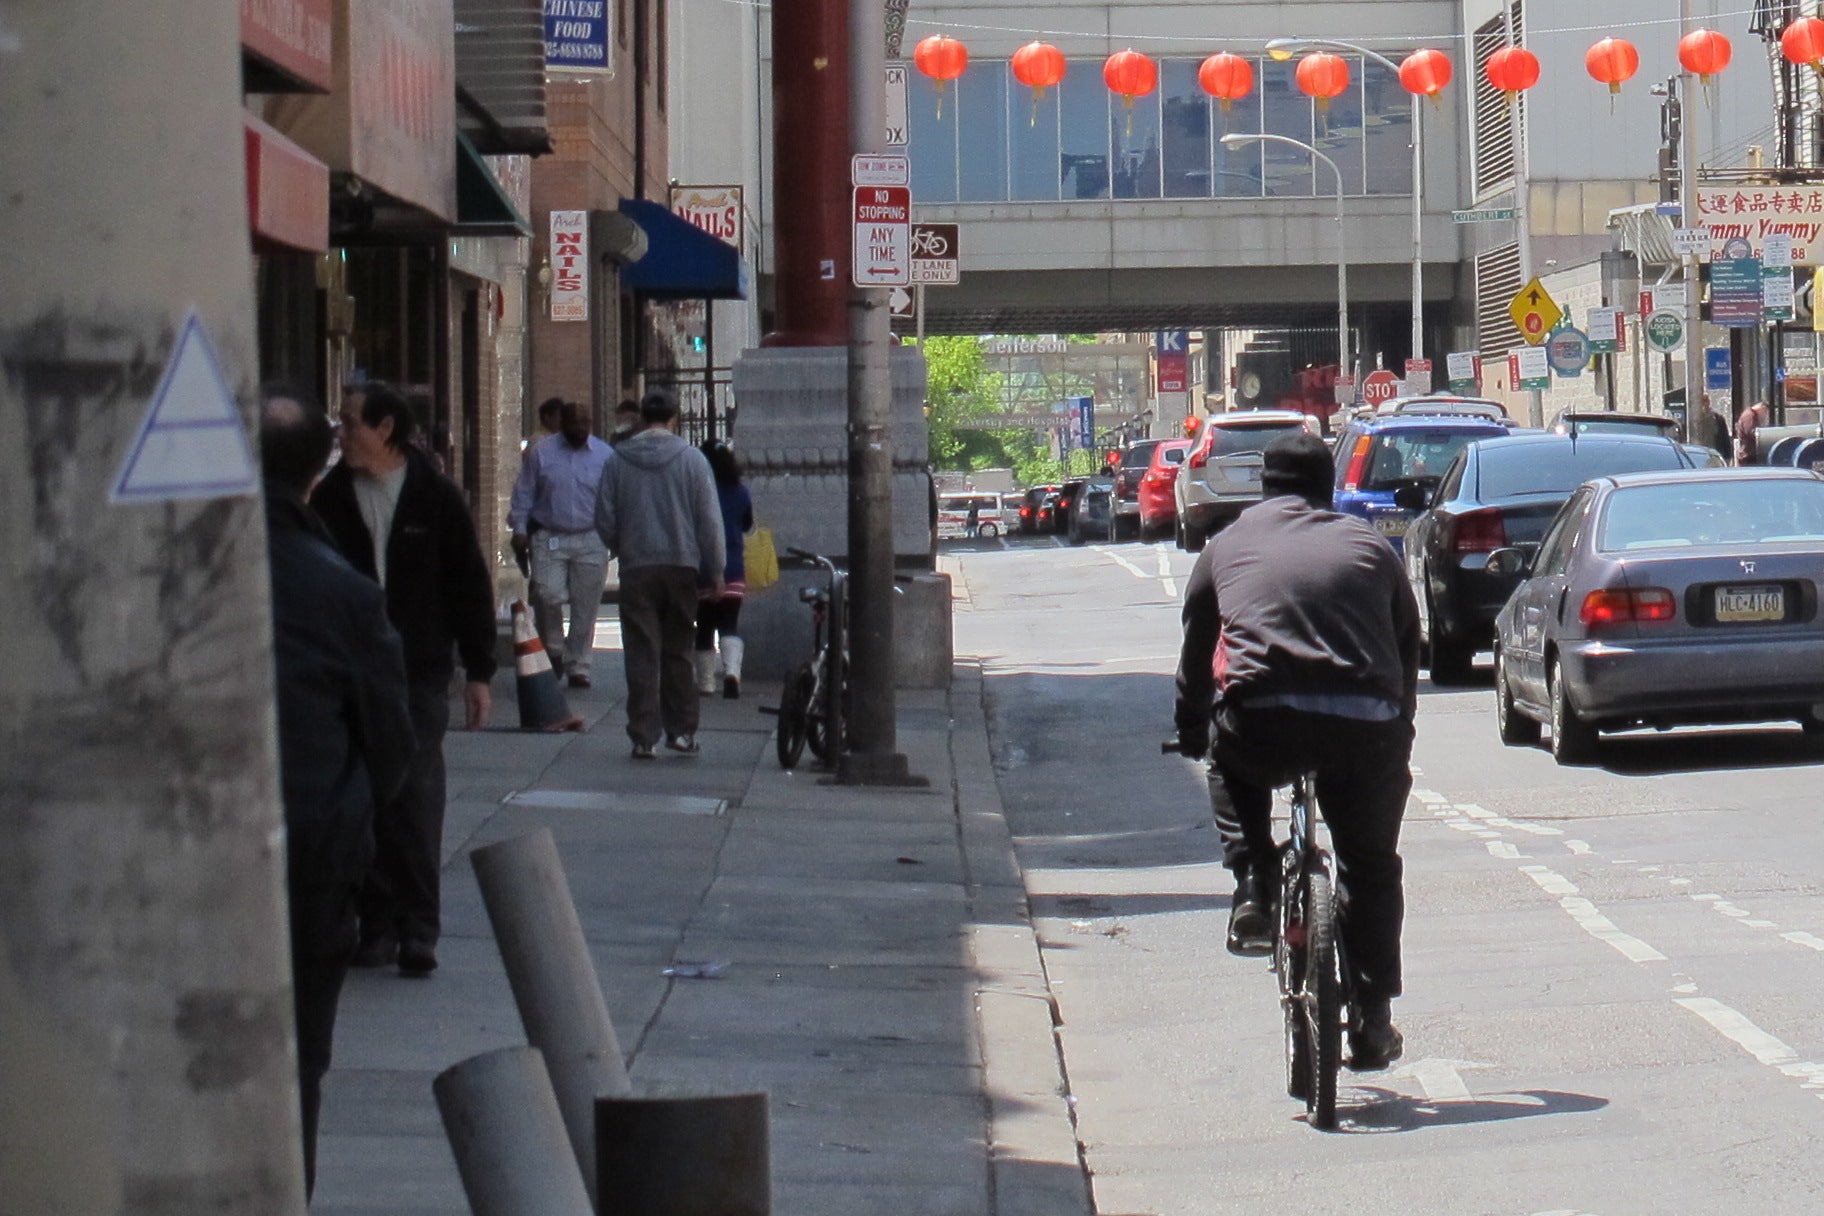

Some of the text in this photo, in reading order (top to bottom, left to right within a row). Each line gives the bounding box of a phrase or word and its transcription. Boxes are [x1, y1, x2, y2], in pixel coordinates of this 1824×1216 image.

[544, 0, 603, 19] CHINESE
[553, 21, 593, 39] FOOD
[875, 189, 890, 204] NO
[859, 205, 906, 220] STOPPING
[869, 227, 895, 243] ANY
[1758, 218, 1822, 244] Yummy
[868, 245, 897, 262] TIME
[555, 232, 583, 292] NAILS
[922, 260, 952, 270] LANE
[922, 271, 951, 281] ONLY
